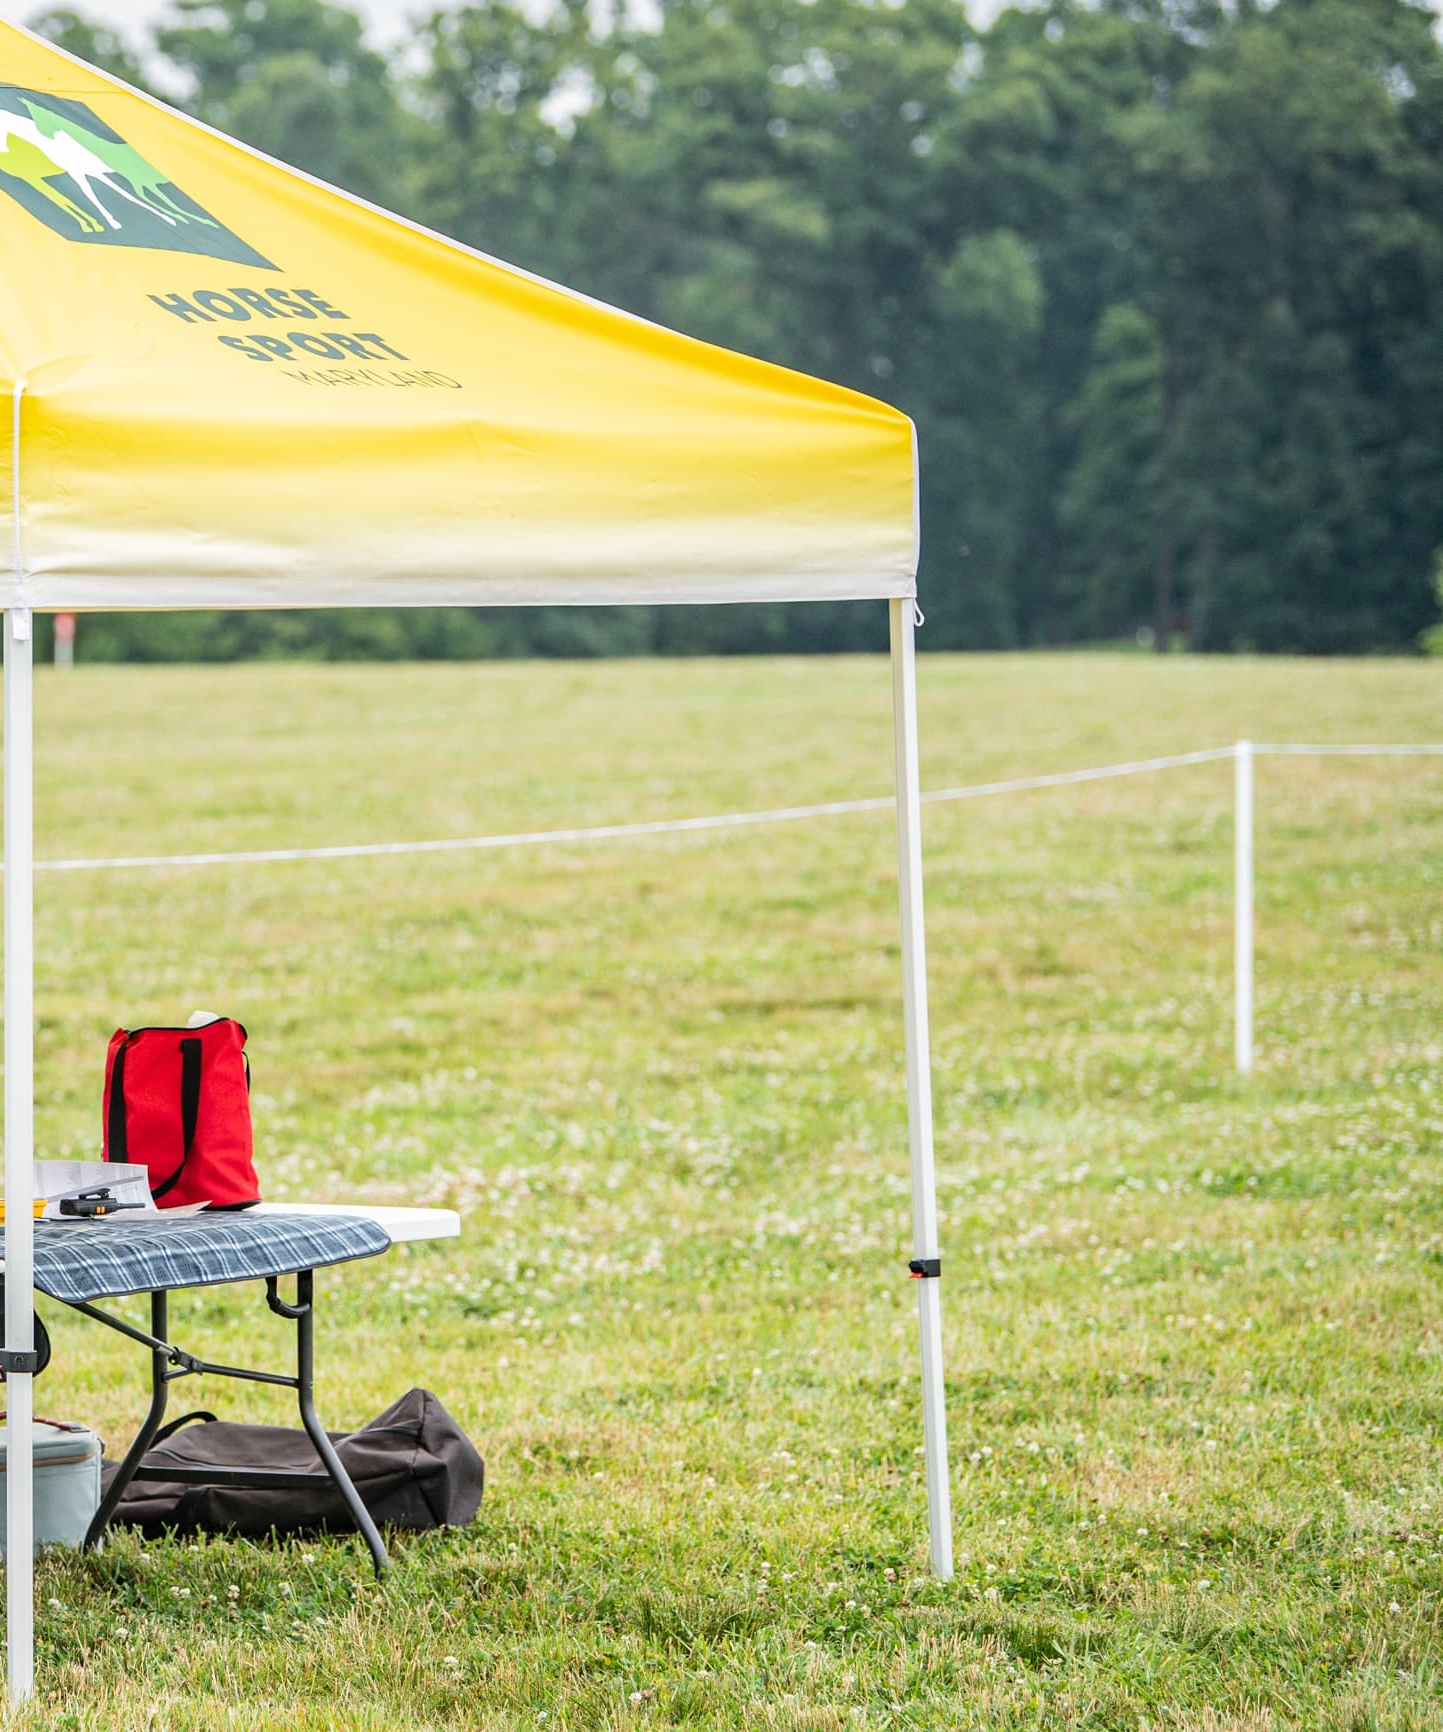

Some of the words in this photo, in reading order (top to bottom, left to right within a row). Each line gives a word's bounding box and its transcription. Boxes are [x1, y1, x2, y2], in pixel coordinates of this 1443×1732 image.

[146, 288, 350, 323] HORSE
[217, 331, 410, 361] SPORT
[279, 369, 463, 388] MARYLAND
